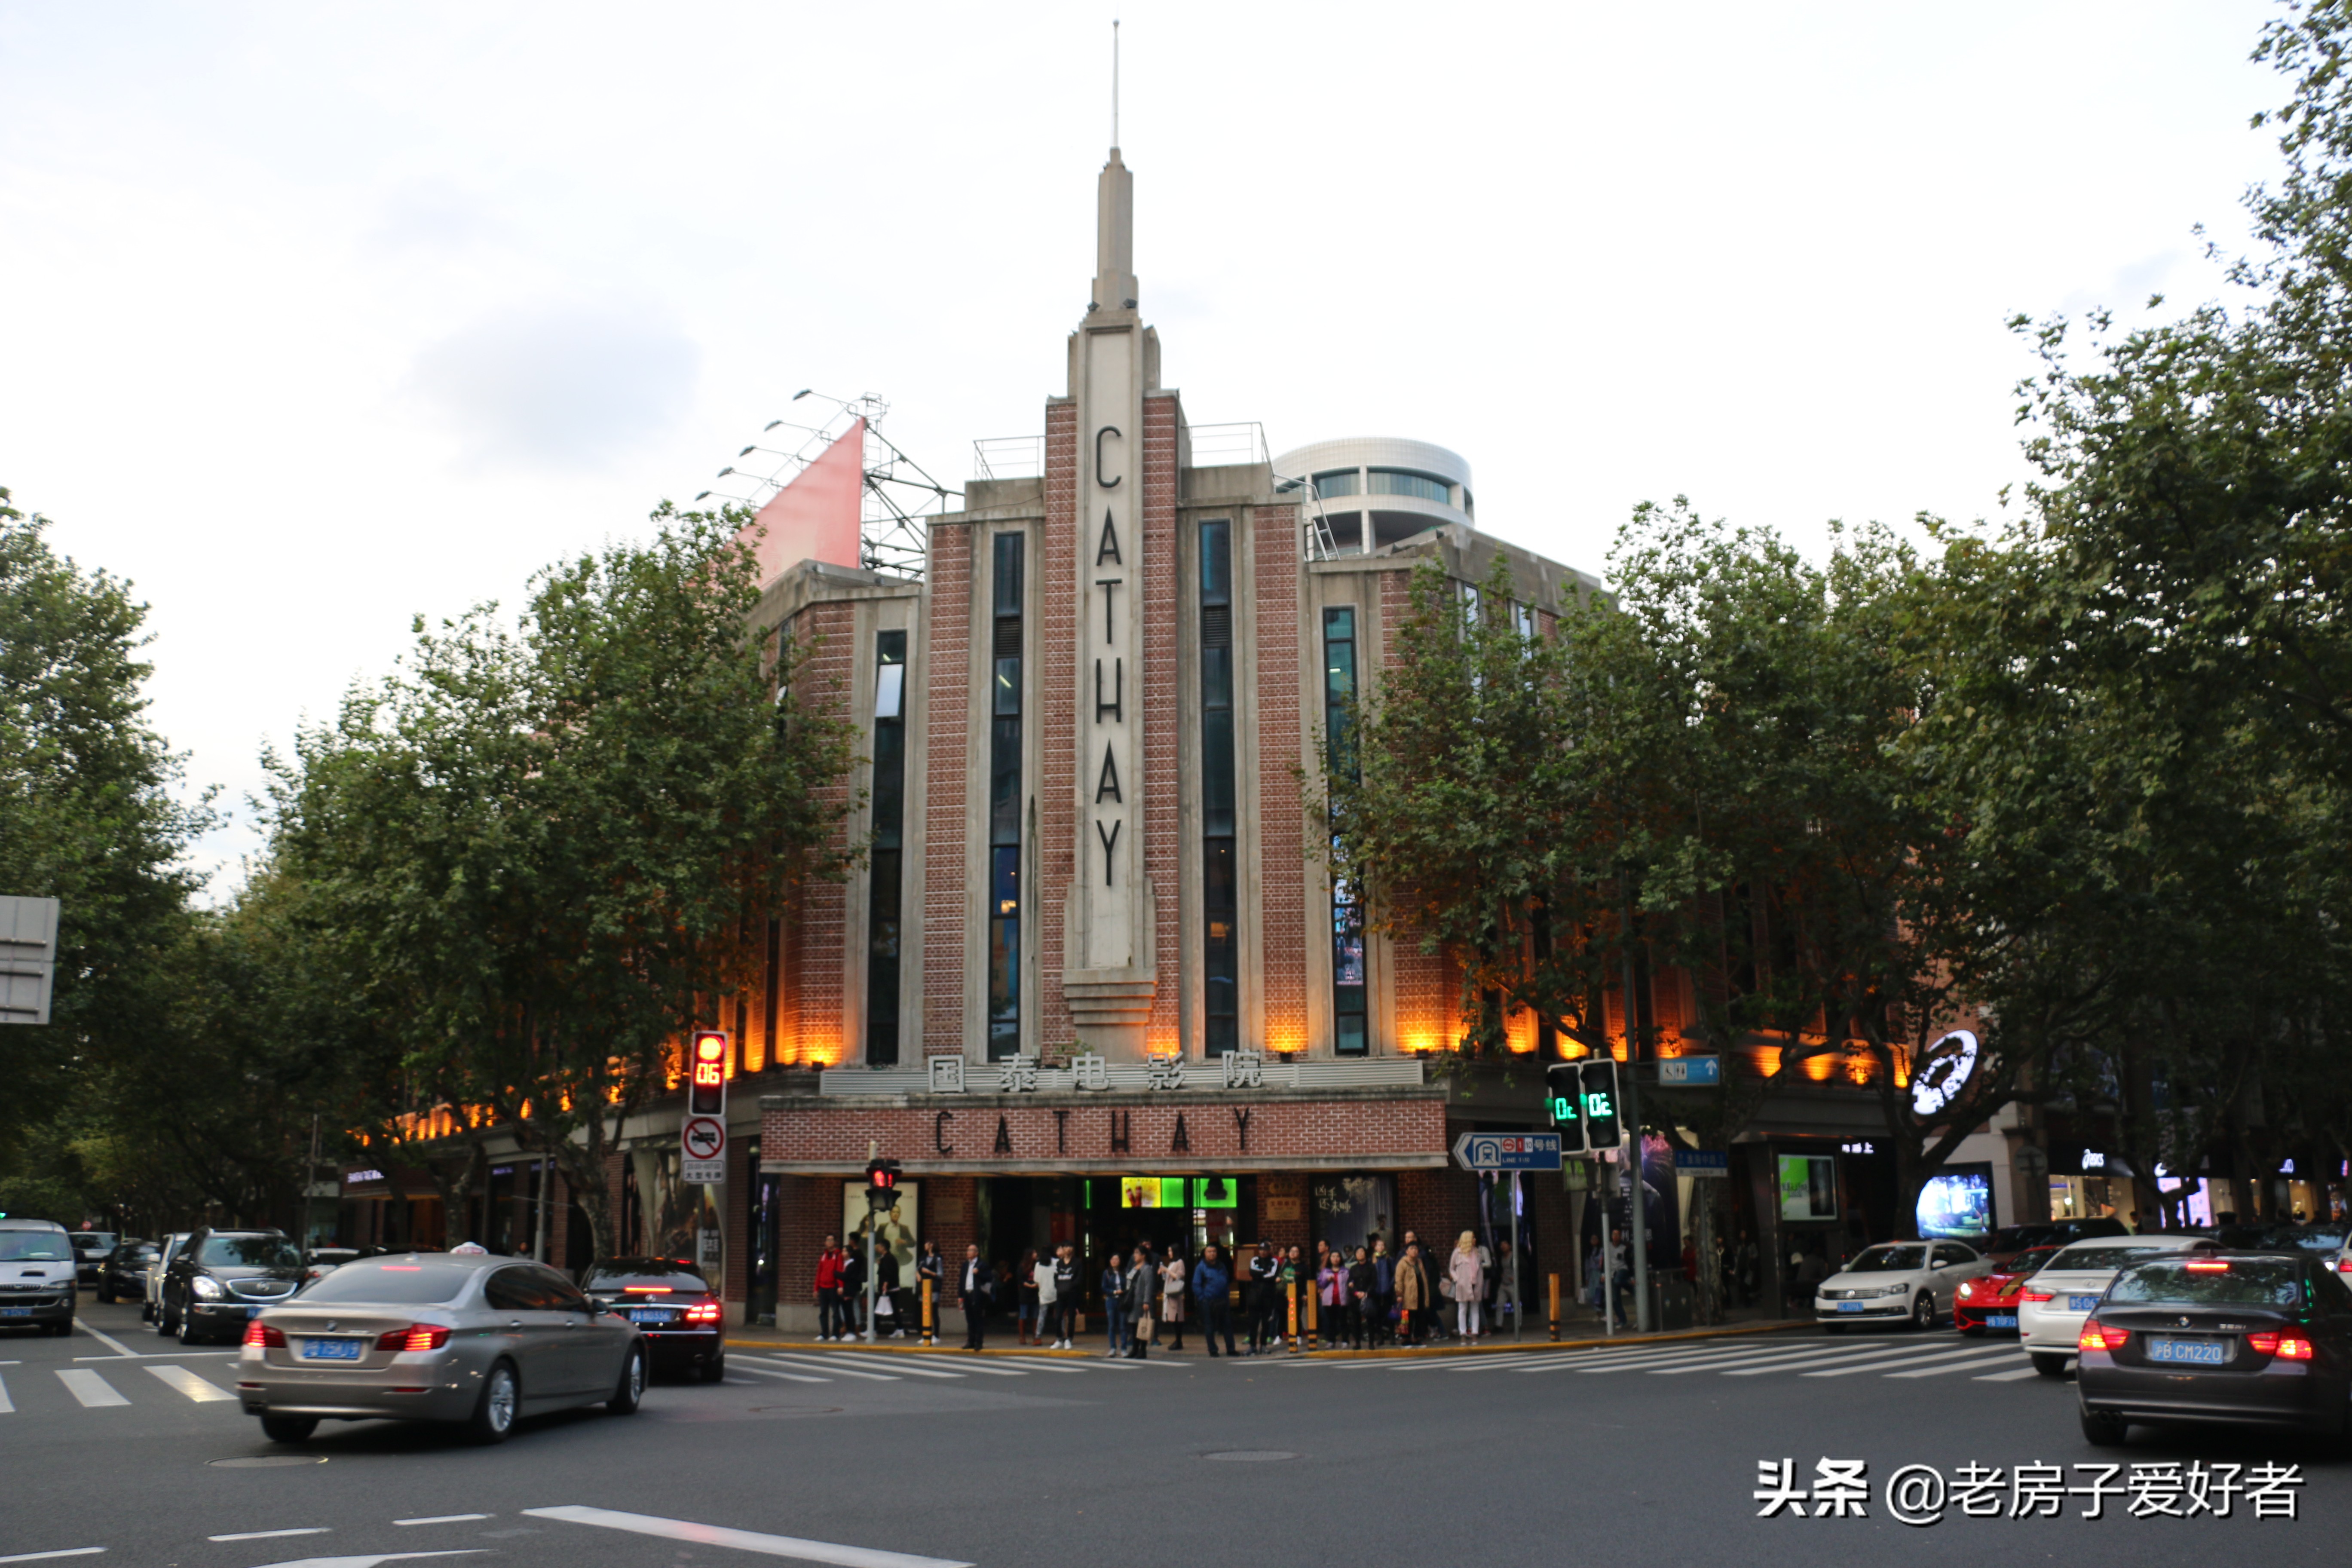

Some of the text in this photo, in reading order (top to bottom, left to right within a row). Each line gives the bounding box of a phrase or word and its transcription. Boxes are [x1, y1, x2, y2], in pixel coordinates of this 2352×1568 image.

[1095, 425, 1123, 887] CATHAY
[696, 1063, 720, 1084] 06
[928, 1048, 1263, 1093] 国泰电影院
[936, 1106, 1250, 1154] CATHAY
[1534, 1139, 1557, 1151] 号线
[2176, 1344, 2221, 1361] CM220
